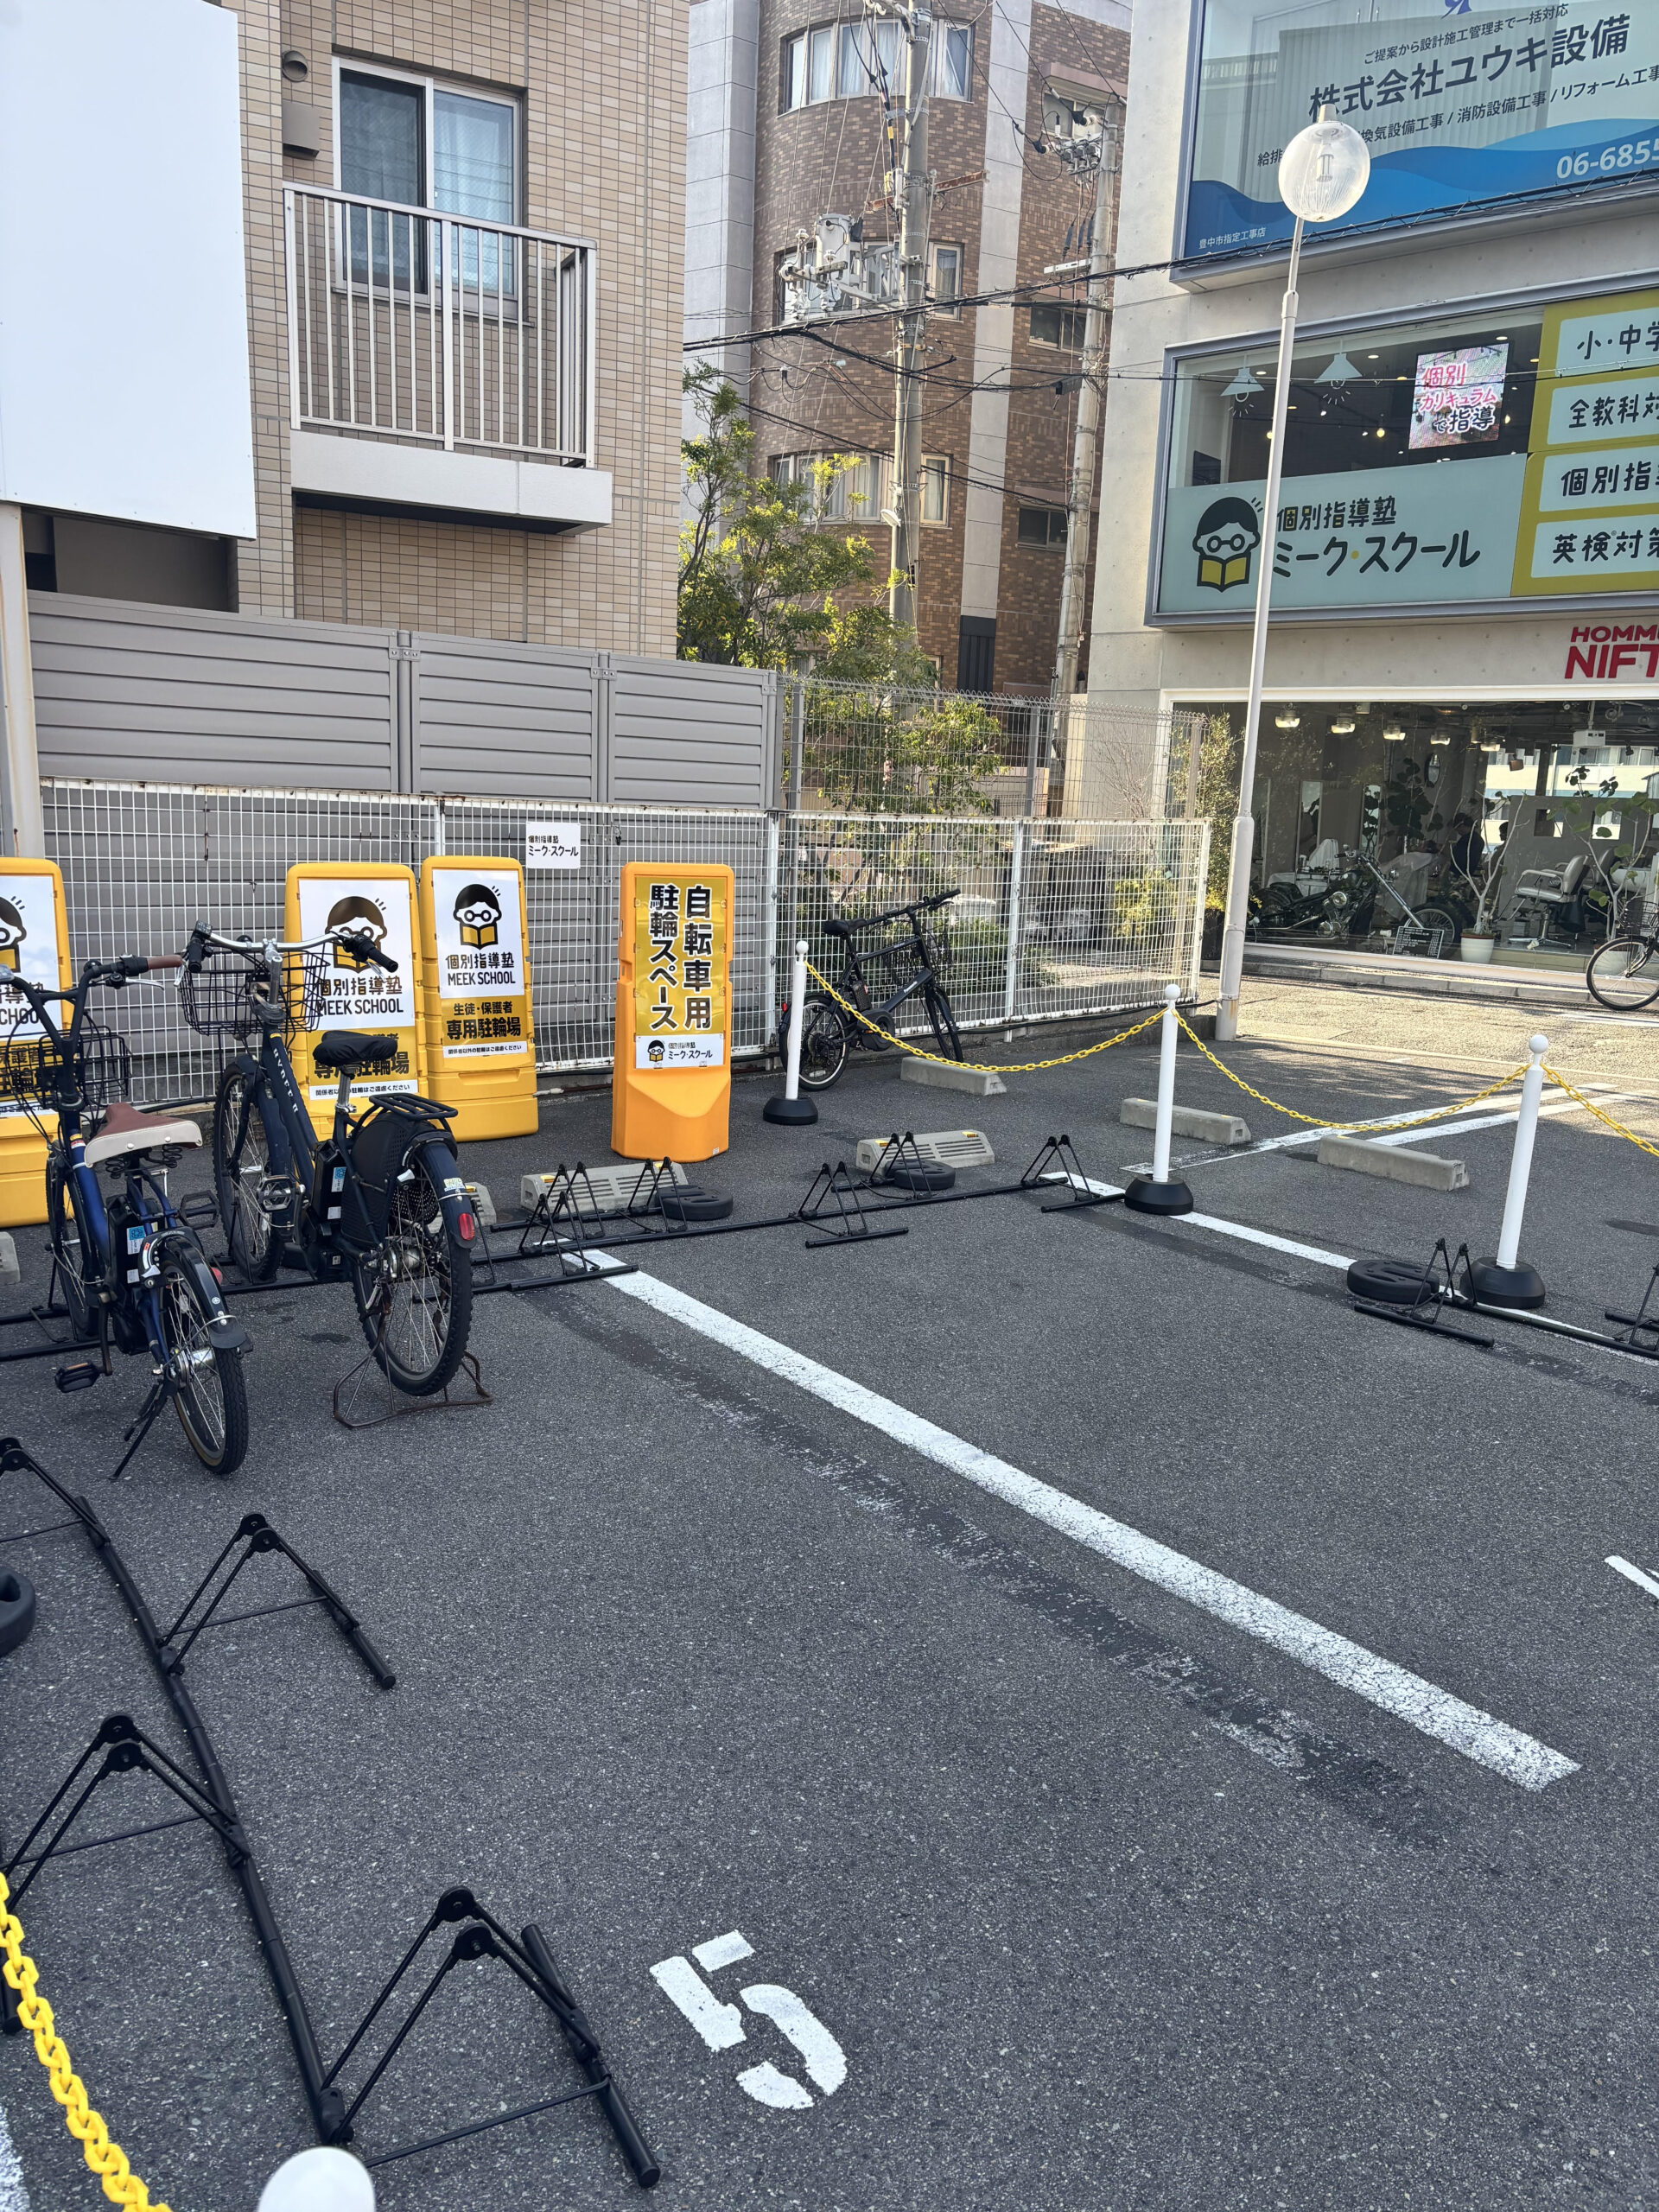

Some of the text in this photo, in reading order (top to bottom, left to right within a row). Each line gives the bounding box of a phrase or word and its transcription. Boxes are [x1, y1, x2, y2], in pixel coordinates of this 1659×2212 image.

[1364, 3, 1568, 64] ご提案から設計施工管理まで一括対応
[1309, 14, 1630, 123] 株式会社ユウキ設備
[1257, 148, 1283, 167] 給排
[1457, 90, 1547, 124] 消防設備工事
[1198, 227, 1266, 249] 豊中市指定工事店
[1421, 363, 1466, 390] 個別
[1420, 388, 1497, 411] カリキュラム
[1435, 406, 1493, 432] で指導
[1560, 461, 1659, 497] 個別指
[1276, 495, 1397, 532] 個別指導塾
[1273, 529, 1481, 578] ミーク・スクール
[1570, 624, 1659, 643] HOMM
[1564, 643, 1659, 679] NIFT
[528, 845, 579, 856] ミーク・スクール
[445, 952, 514, 969] 個別指導塾
[649, 884, 680, 1029] 駐輪スペース
[683, 885, 713, 1029] 自転車用
[317, 976, 403, 996] 個別指導塾
[448, 971, 516, 986] MEEK SCHOOL
[316, 998, 404, 1015] MEEK SCHOOL
[454, 1001, 513, 1016] 生徒・保護者
[446, 1016, 521, 1039] 専用駐輪場
[315, 1052, 410, 1078] 専駐輪場
[668, 1049, 713, 1059] ミーク・スクール
[649, 1929, 848, 2110] 5
